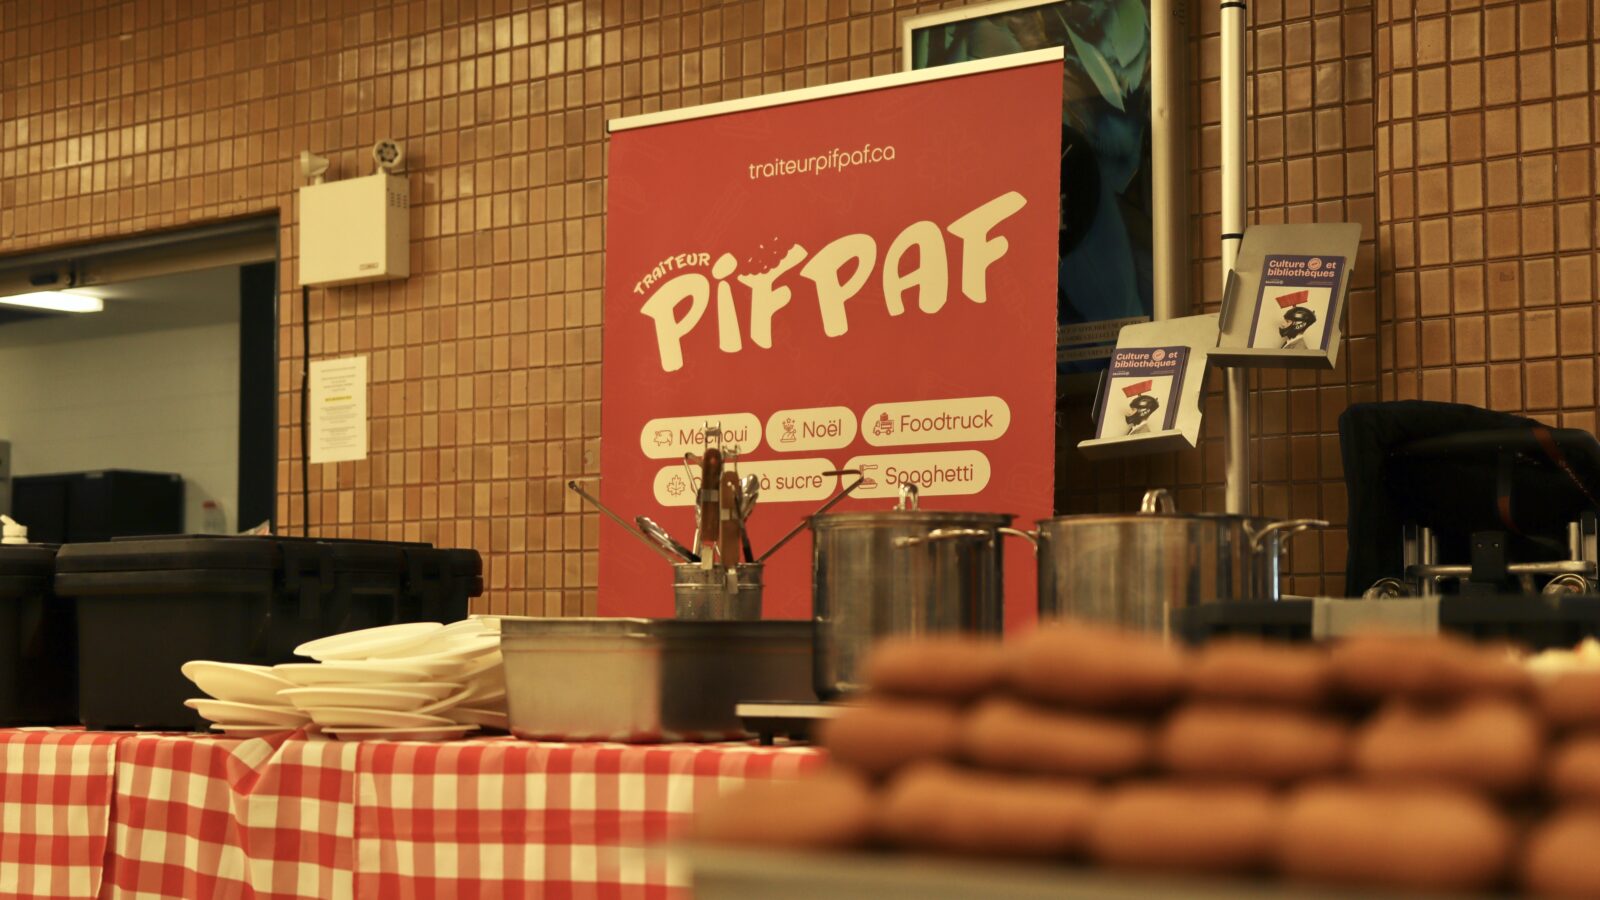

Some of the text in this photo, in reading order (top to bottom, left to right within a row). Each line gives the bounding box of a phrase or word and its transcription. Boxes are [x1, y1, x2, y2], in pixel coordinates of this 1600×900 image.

[749, 144, 896, 179] traiteurpifpaf.ca
[1269, 259, 1305, 268] Culture
[1267, 268, 1335, 278] bibliothèques
[1116, 352, 1149, 360] Culture
[1168, 351, 1178, 359] et
[1114, 360, 1177, 368] bibliothèques
[802, 419, 842, 438] Noël
[900, 409, 994, 432] Foodtruck
[760, 474, 823, 490] à sucre
[885, 464, 974, 488] Spaghetti
